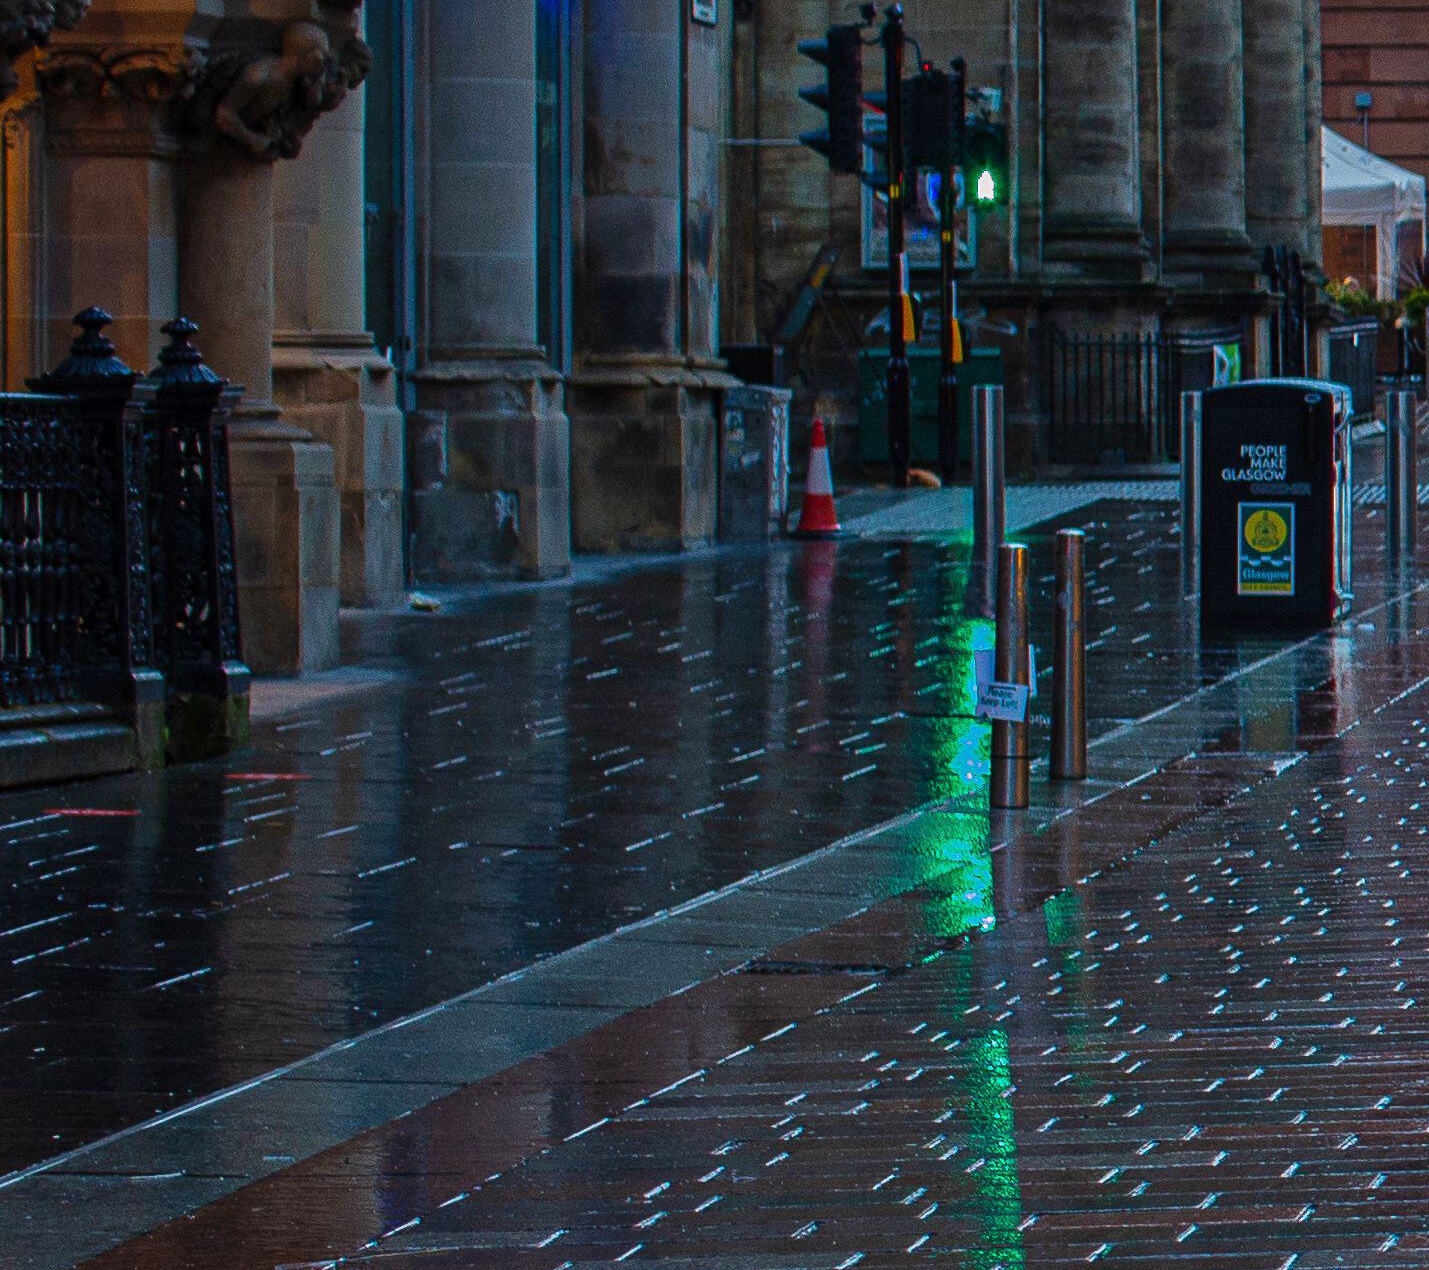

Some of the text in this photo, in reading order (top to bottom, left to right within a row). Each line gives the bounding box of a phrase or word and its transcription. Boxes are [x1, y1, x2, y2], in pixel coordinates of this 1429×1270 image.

[1240, 445, 1287, 458] PEOPLE
[1250, 458, 1286, 469] MAKE
[1222, 468, 1287, 481] GLASGOW
[1242, 568, 1290, 581] Glasgow
